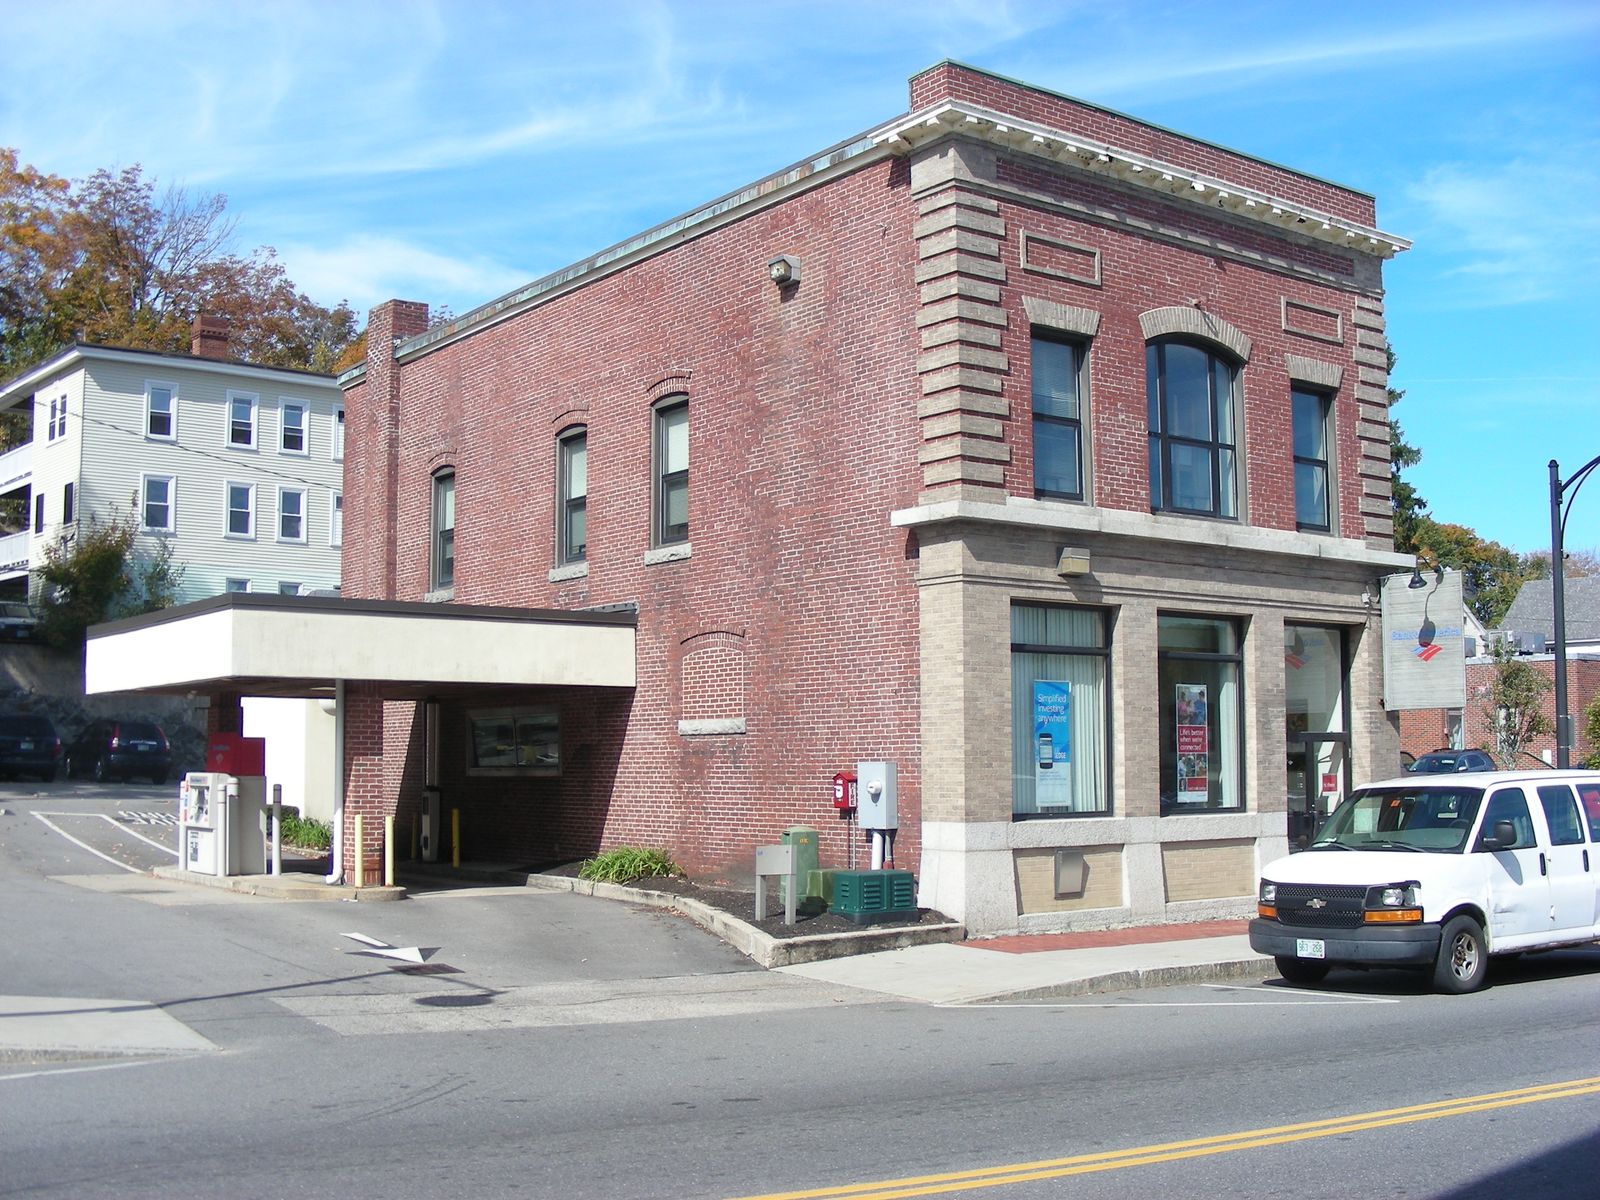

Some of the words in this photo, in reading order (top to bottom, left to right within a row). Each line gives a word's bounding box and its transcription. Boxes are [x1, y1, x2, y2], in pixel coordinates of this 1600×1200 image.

[1038, 694, 1066, 704] Simplified
[1038, 704, 1065, 714] investing
[1038, 715, 1067, 726] anywhere
